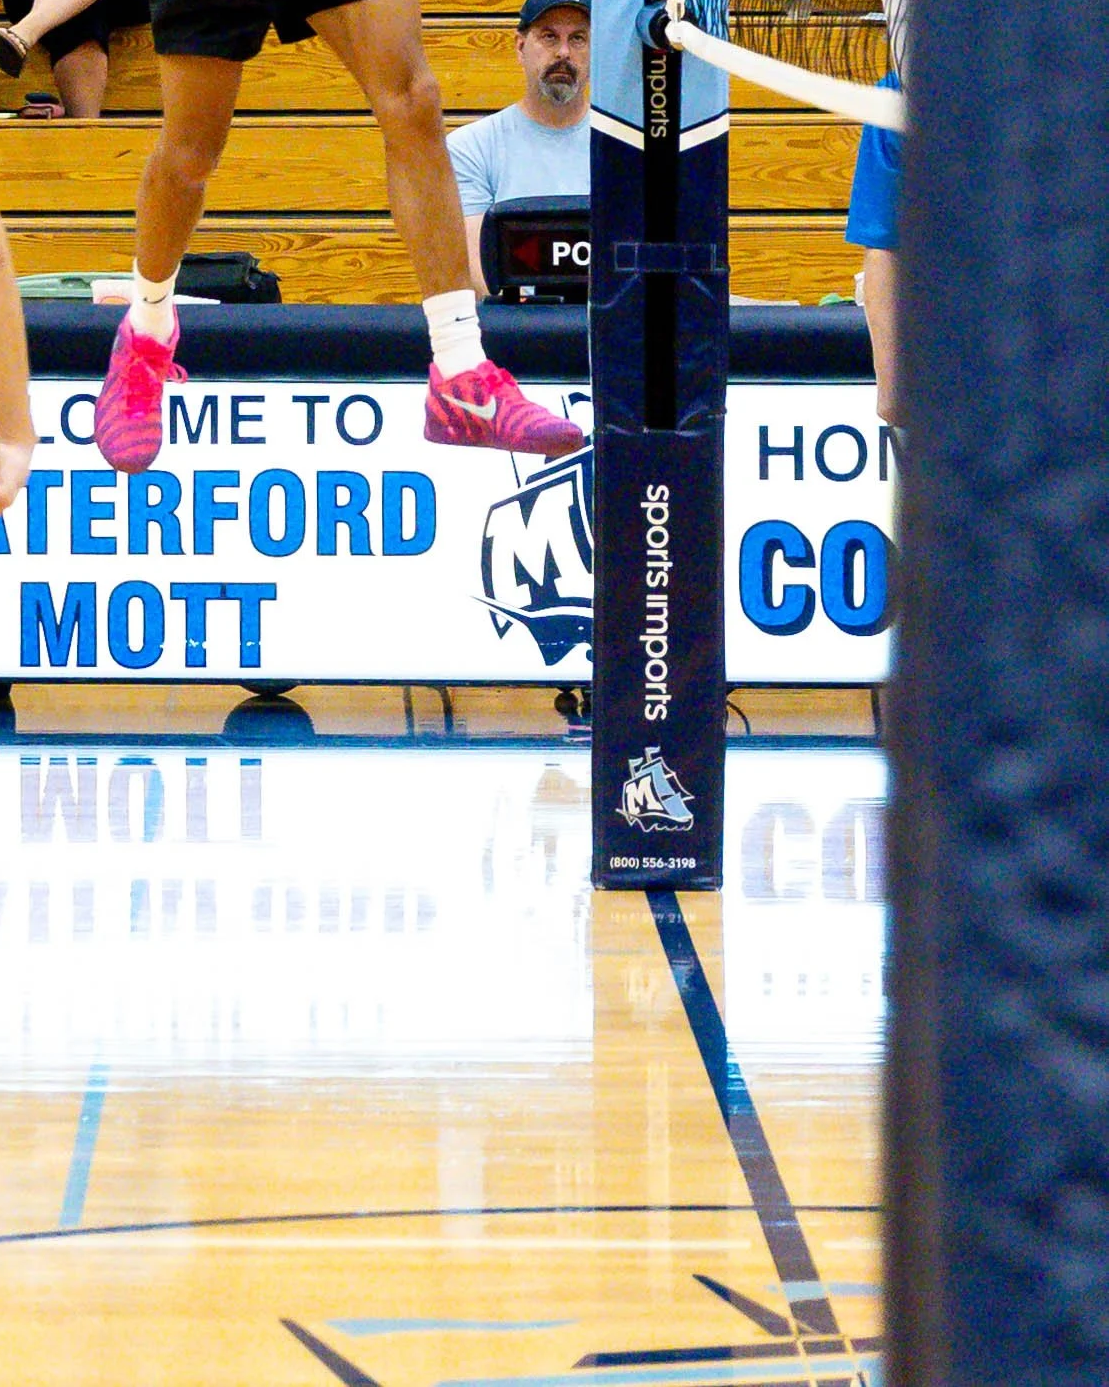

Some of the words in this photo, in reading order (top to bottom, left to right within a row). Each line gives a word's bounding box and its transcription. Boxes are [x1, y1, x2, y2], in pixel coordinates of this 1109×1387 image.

[292, 394, 383, 446] TO
[640, 484, 673, 588] sports
[739, 519, 896, 636] CO
[20, 580, 277, 670] MOTT
[639, 594, 672, 721] imports
[609, 856, 639, 870] (800)
[642, 856, 696, 869] 556-3198
